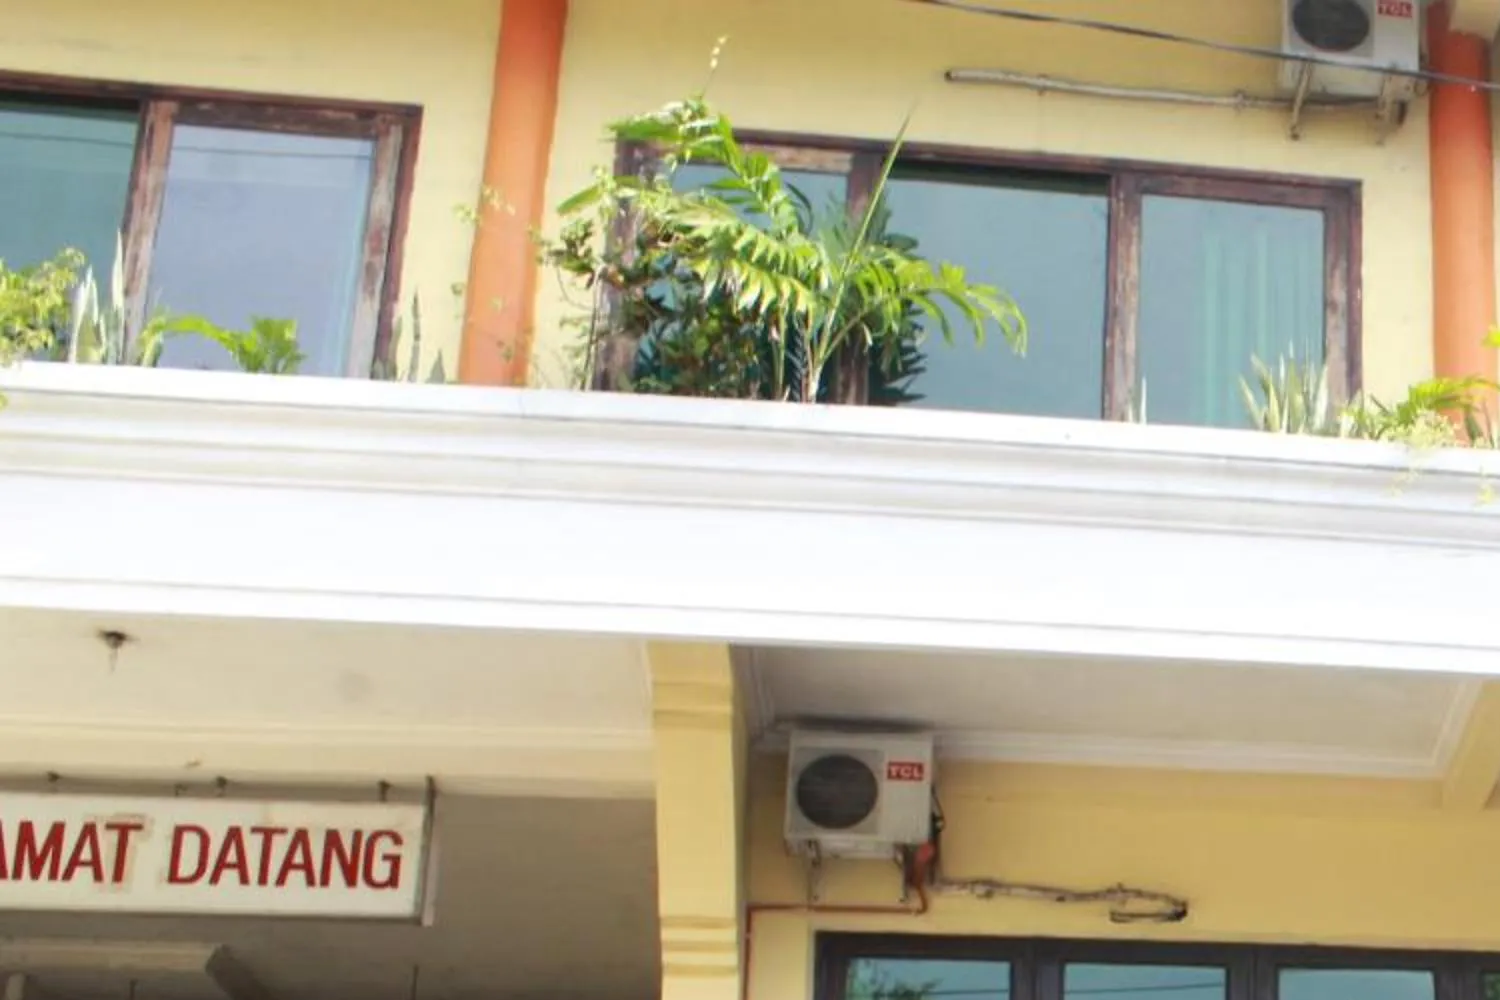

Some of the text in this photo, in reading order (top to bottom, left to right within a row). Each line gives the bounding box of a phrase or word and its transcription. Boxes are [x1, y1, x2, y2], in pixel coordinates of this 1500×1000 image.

[1378, 1, 1411, 16] TCL
[888, 763, 923, 780] TCL
[0, 817, 404, 889] MAT DATANG
